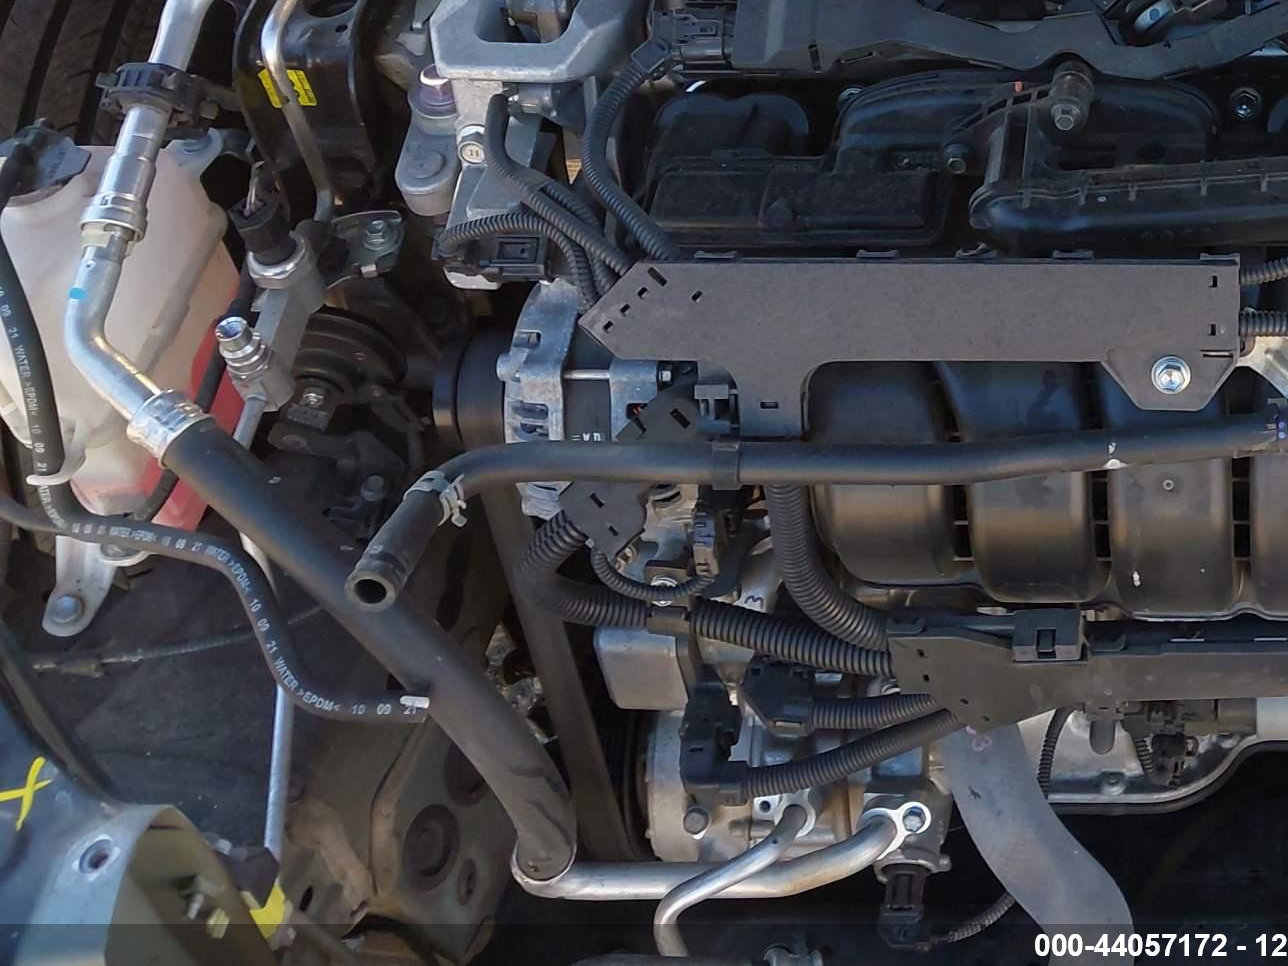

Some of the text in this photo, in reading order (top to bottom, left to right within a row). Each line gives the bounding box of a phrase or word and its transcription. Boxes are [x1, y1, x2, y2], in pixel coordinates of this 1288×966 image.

[14, 344, 32, 378] WATER
[205, 545, 228, 563] WATER
[249, 597, 261, 613] 10
[257, 617, 271, 632] 09
[266, 640, 278, 654] 21
[274, 656, 299, 694] WATER
[351, 703, 366, 715] 10
[376, 703, 392, 715] 09
